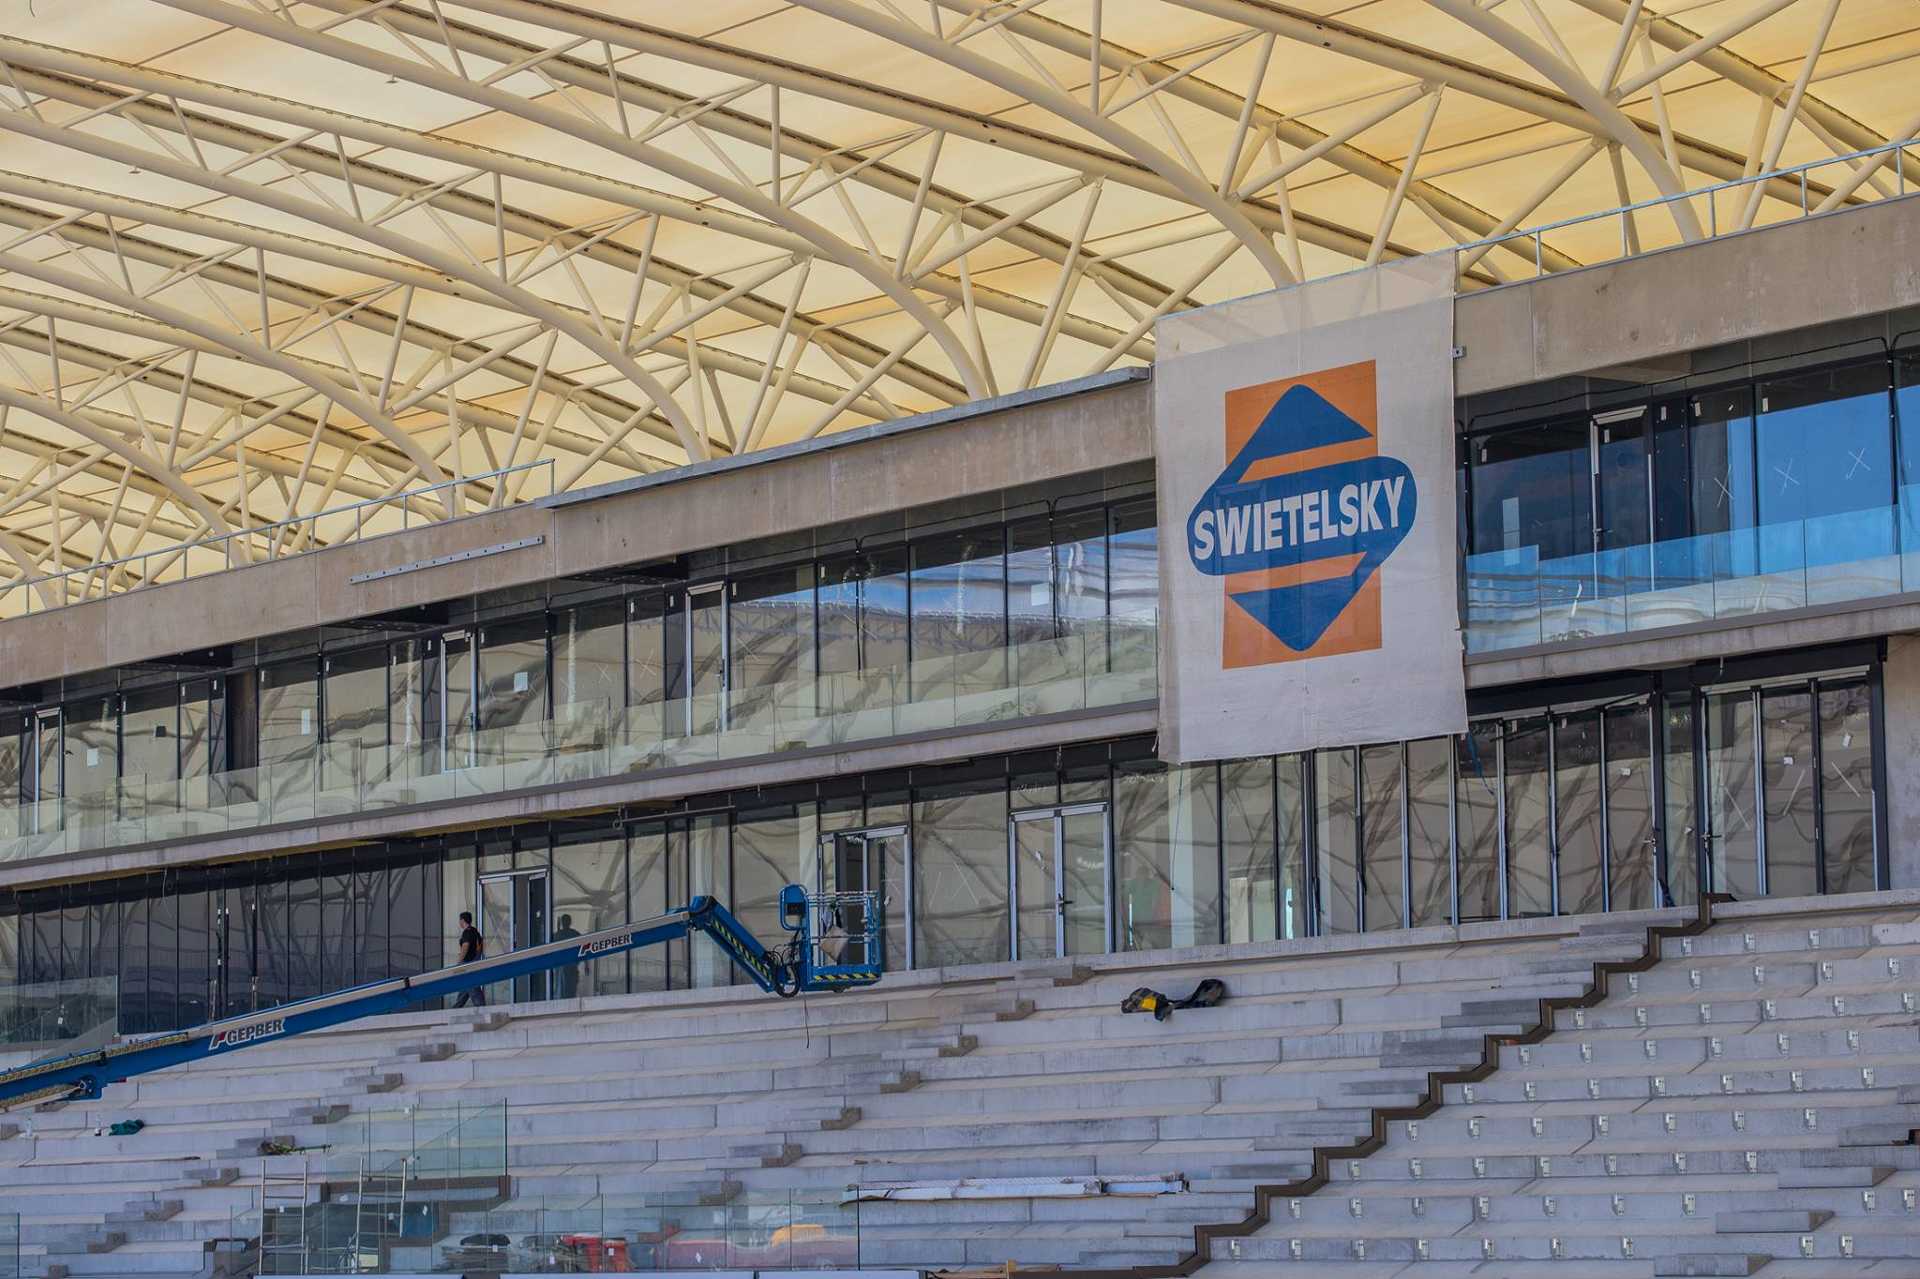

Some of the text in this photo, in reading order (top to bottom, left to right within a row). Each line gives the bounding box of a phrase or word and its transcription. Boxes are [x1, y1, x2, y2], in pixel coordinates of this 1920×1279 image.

[1194, 476, 1405, 560] SWIETELSKY
[591, 934, 631, 952] GEPBER
[227, 1020, 283, 1043] GEPBER
